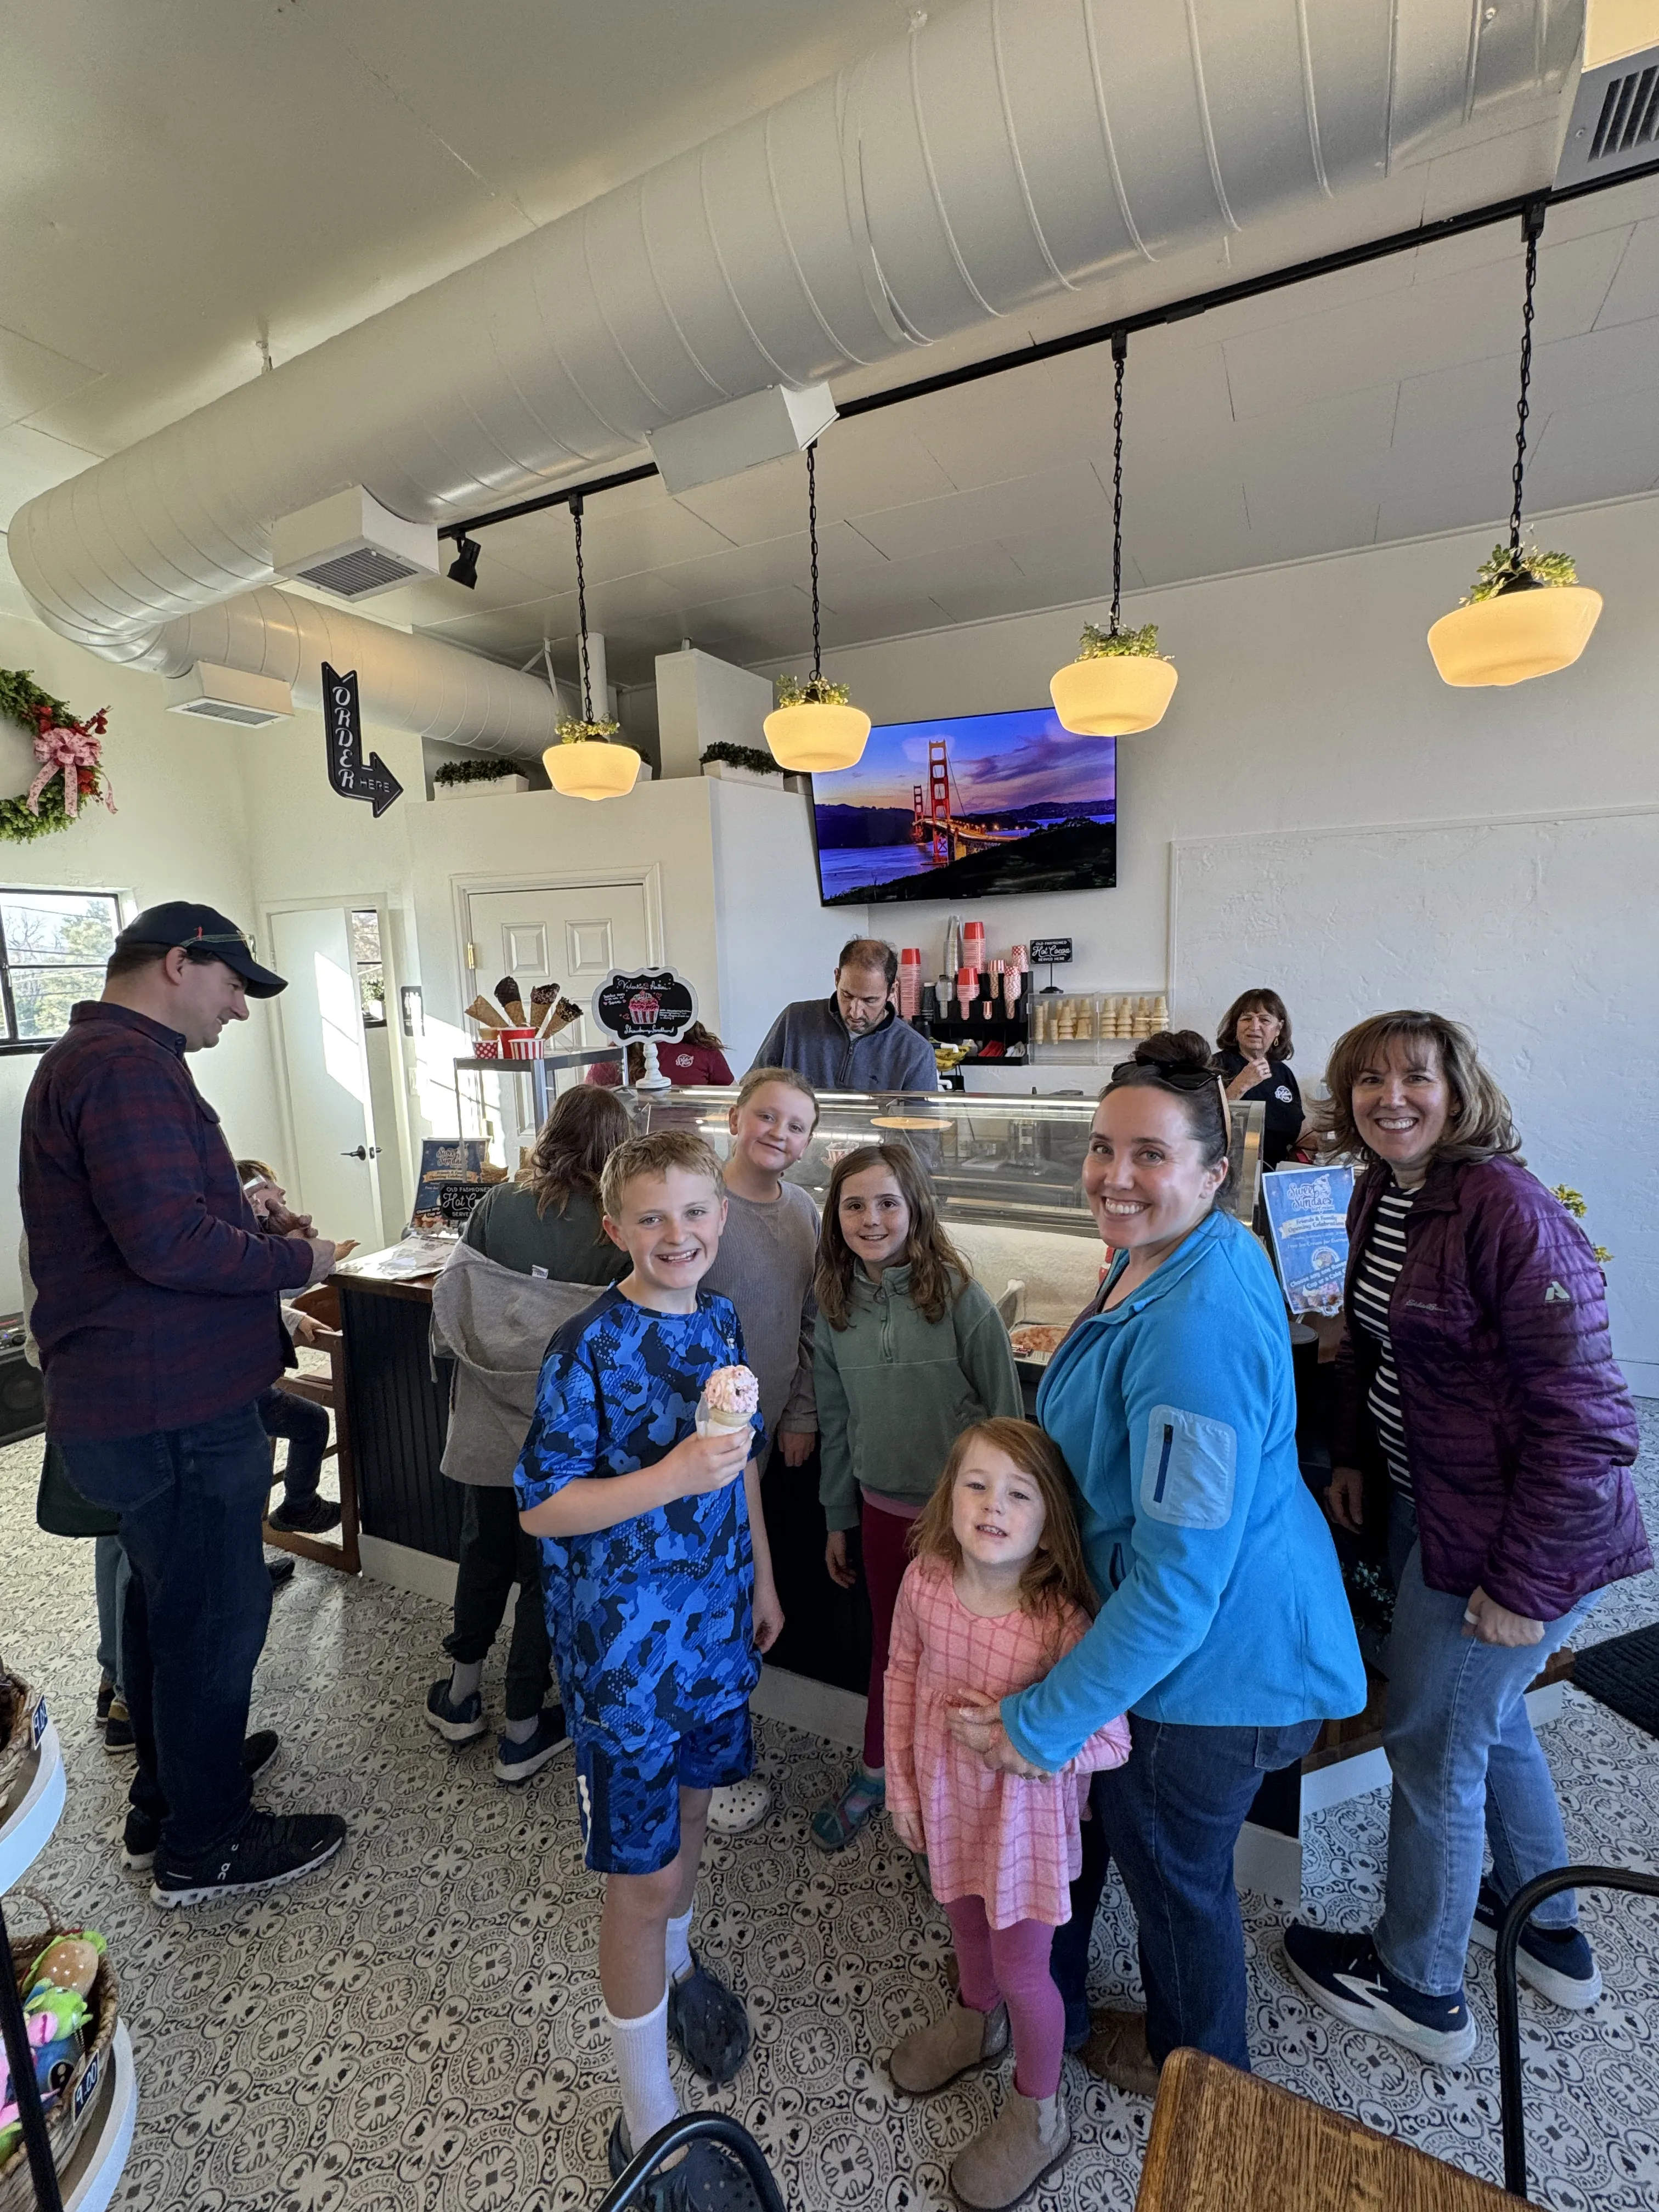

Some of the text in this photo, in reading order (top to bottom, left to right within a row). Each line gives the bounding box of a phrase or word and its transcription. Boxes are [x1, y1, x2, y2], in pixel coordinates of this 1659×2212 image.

[332, 686, 355, 789] ORDER
[360, 777, 391, 793] HERE
[1032, 945, 1071, 958] Hot Cocoa
[1288, 1183, 1315, 1198] Sweet
[443, 1193, 468, 1211] Hot
[1293, 1193, 1332, 1210] Sundaes
[1296, 1216, 1314, 1224] Friends
[1288, 1224, 1311, 1233] Opening
[1290, 1276, 1310, 1288] Choose
[76, 2061, 97, 2105] 9.00
